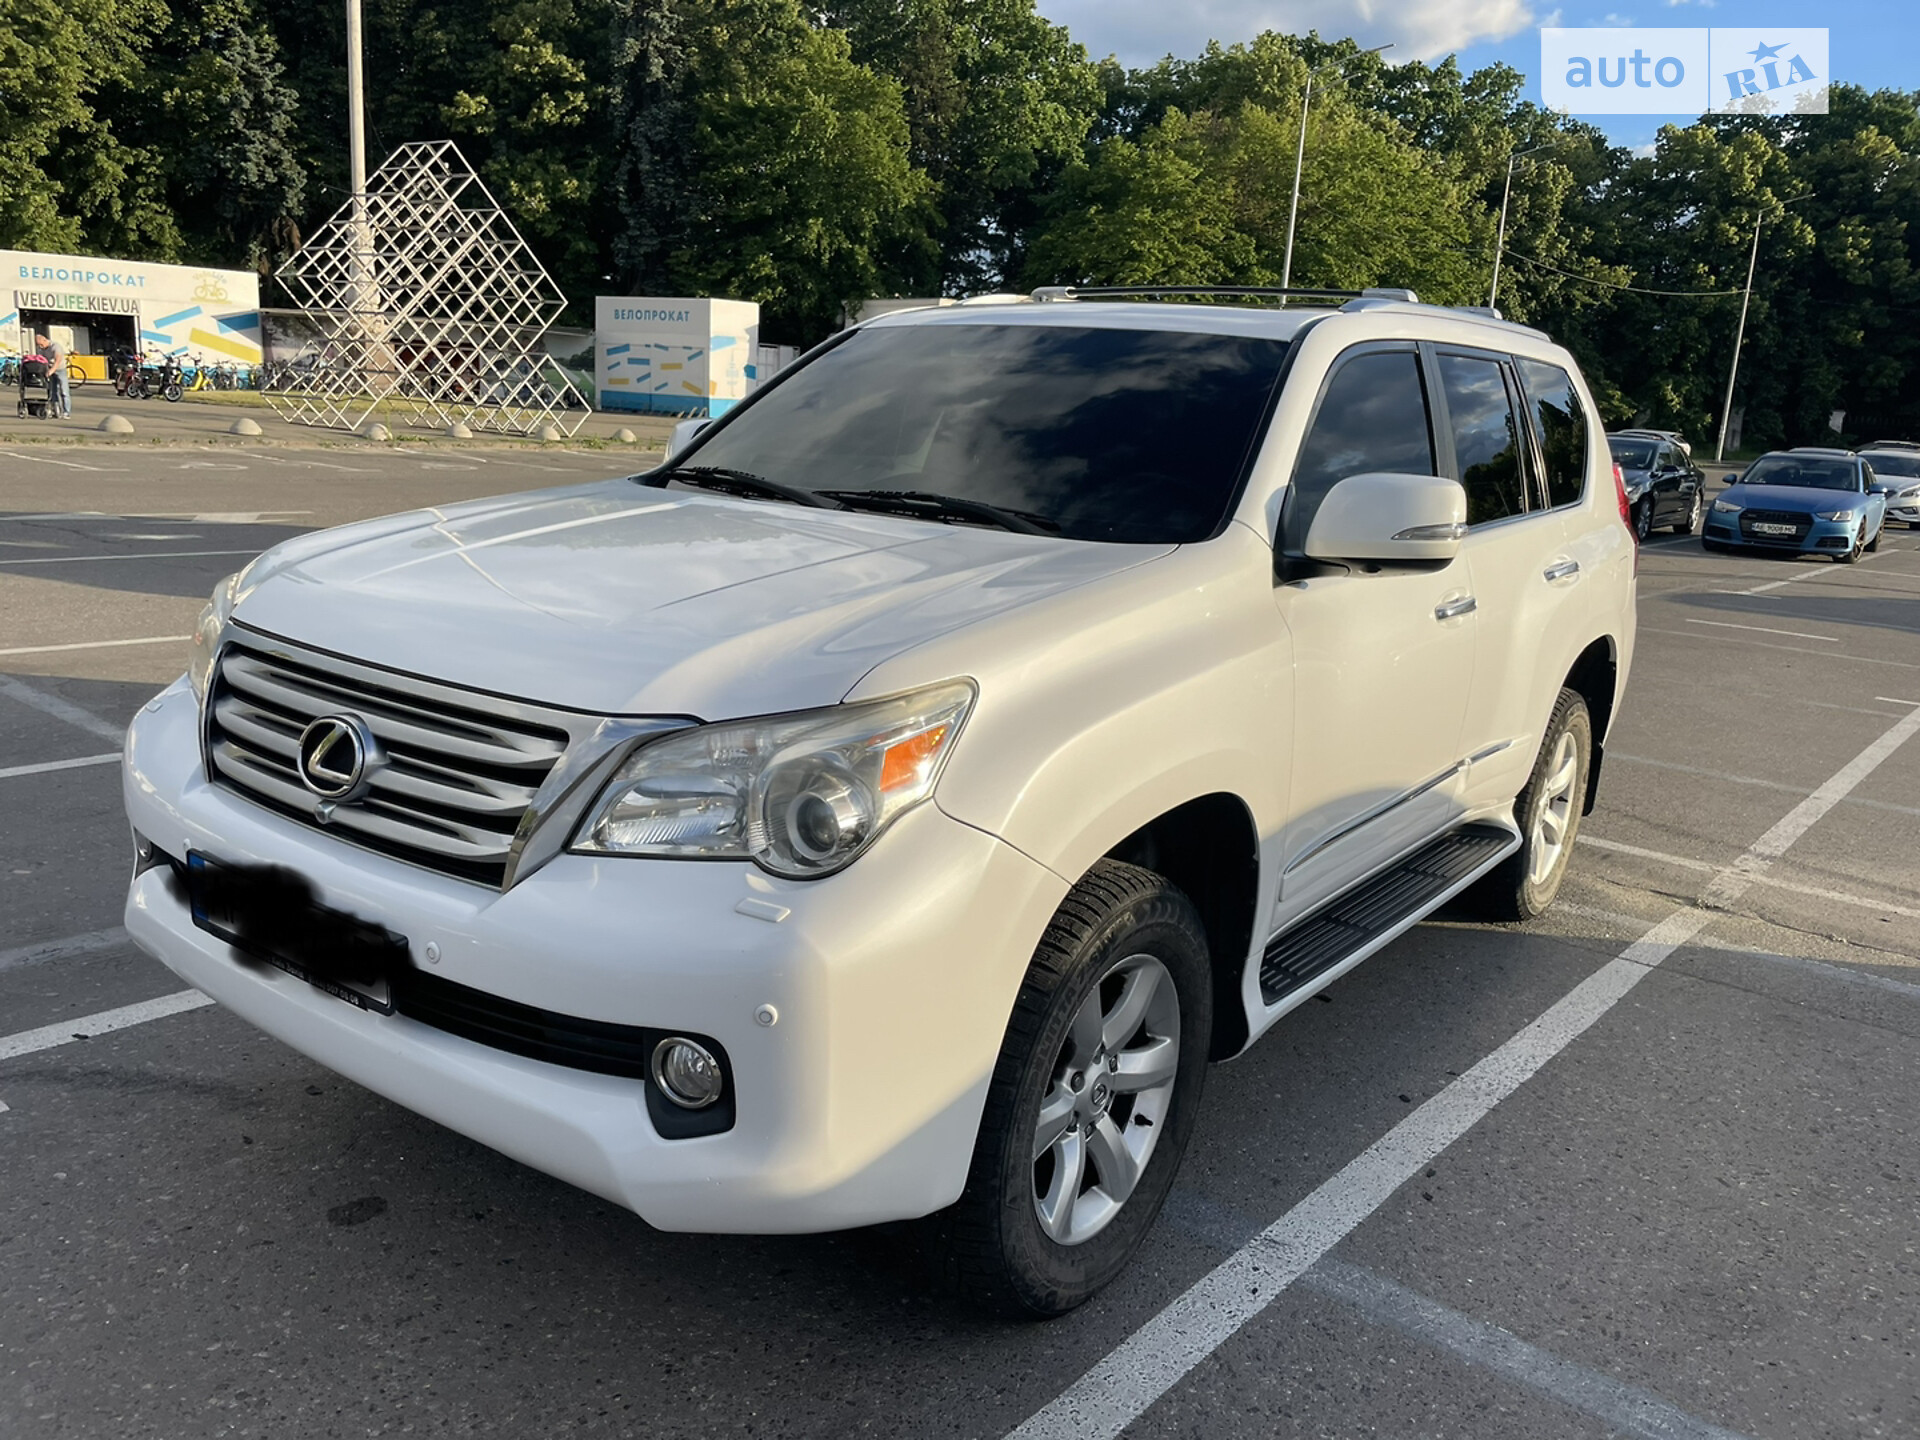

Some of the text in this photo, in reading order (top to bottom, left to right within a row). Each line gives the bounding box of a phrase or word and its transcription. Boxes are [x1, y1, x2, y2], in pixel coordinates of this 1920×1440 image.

[19, 265, 146, 287] ВЕЛОПРОКАТ
[19, 291, 140, 314] VELOLIFE.KIEV.UA
[614, 308, 690, 322] ВЕЛОПРОКАТ
